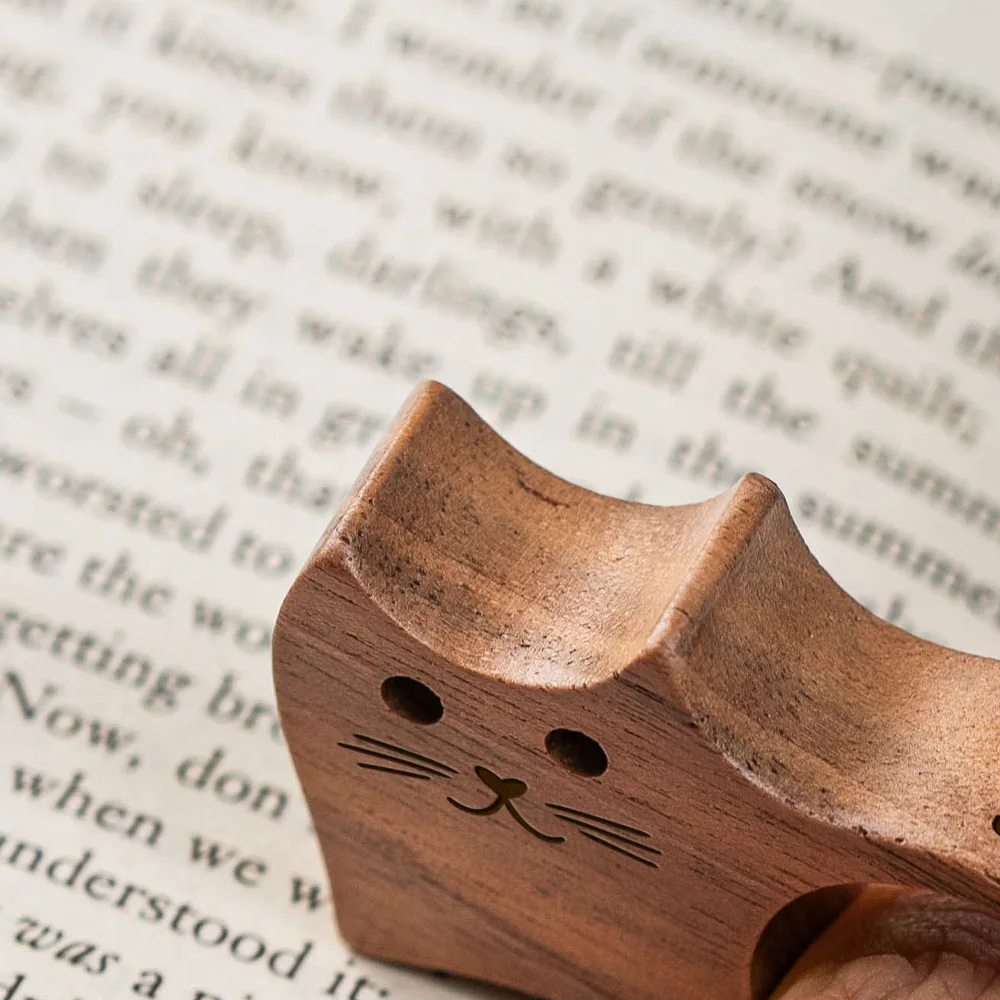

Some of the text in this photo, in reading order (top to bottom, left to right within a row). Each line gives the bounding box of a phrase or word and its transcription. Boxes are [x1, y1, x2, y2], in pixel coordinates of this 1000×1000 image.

[79, 554, 171, 612] the
[233, 533, 290, 572] to
[14, 768, 267, 885] when we
[0, 836, 313, 979] nderstood
[15, 919, 119, 973] was
[133, 972, 163, 999] a
